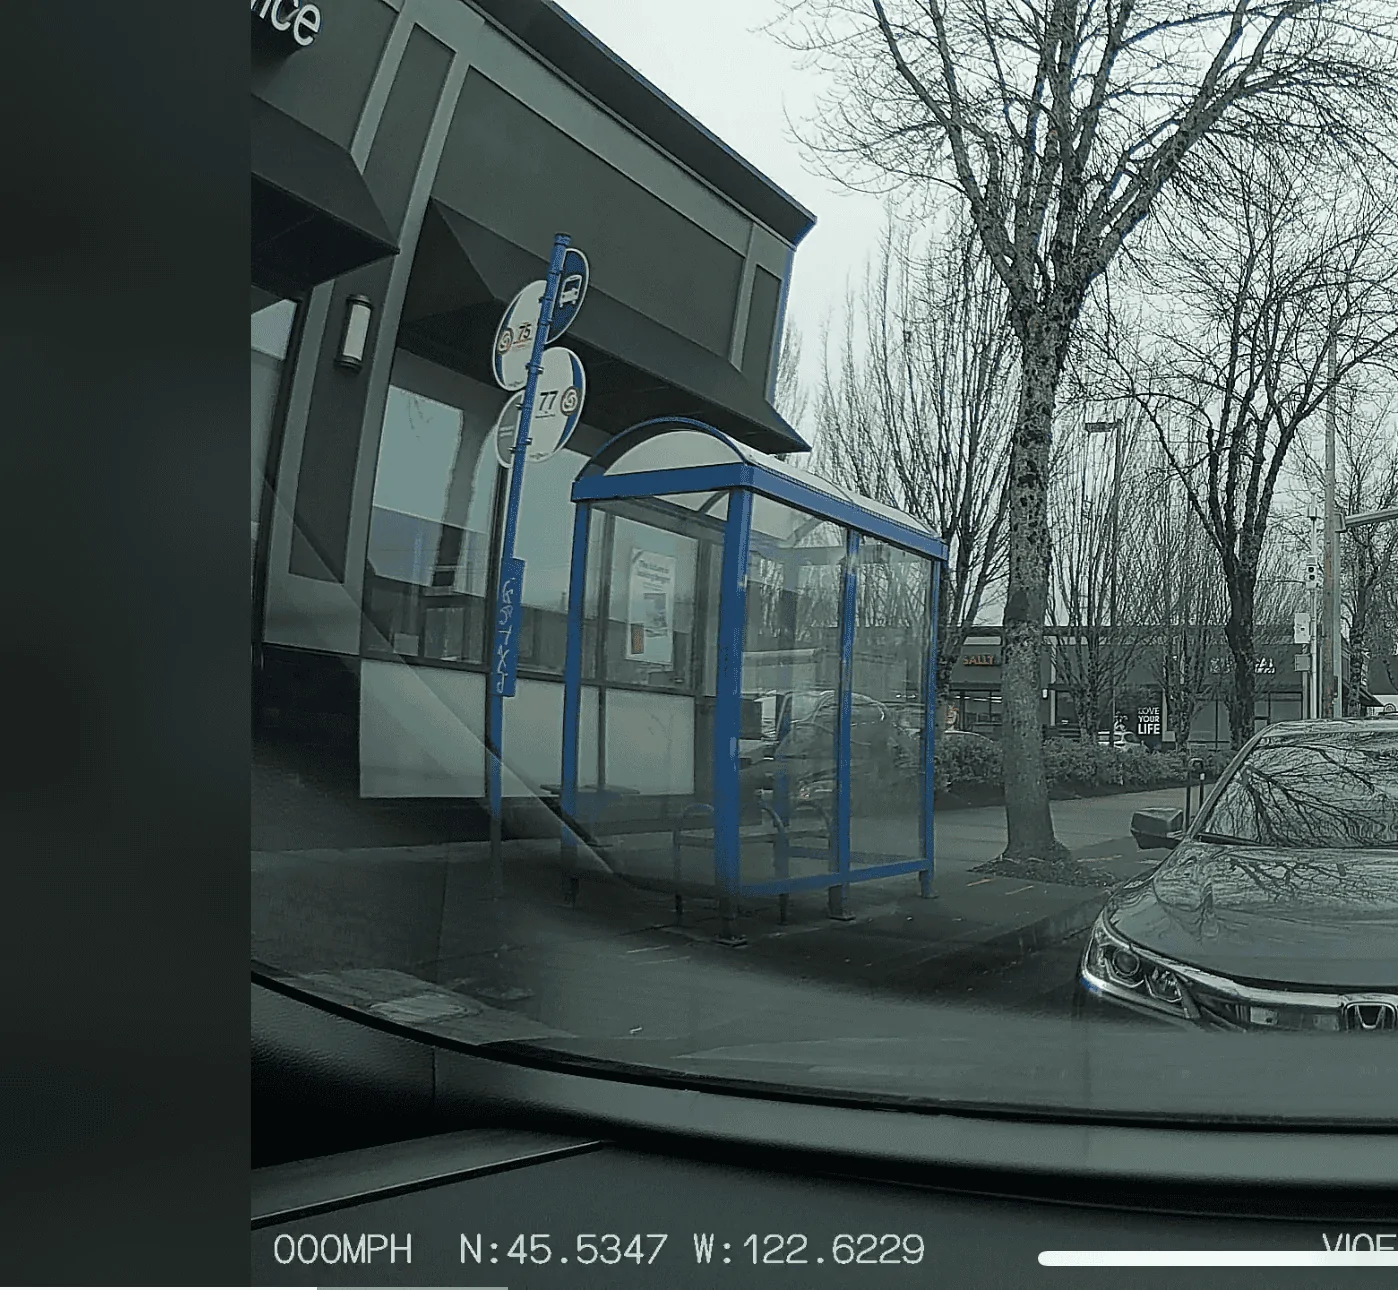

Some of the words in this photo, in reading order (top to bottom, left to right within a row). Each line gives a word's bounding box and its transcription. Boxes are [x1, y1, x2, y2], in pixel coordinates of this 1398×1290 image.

[519, 323, 531, 341] 75
[539, 390, 559, 411] 77
[963, 655, 995, 666] SALLY
[1138, 706, 1160, 715] LOVE
[1138, 715, 1160, 723] YOUR
[1138, 723, 1161, 735] LIFE
